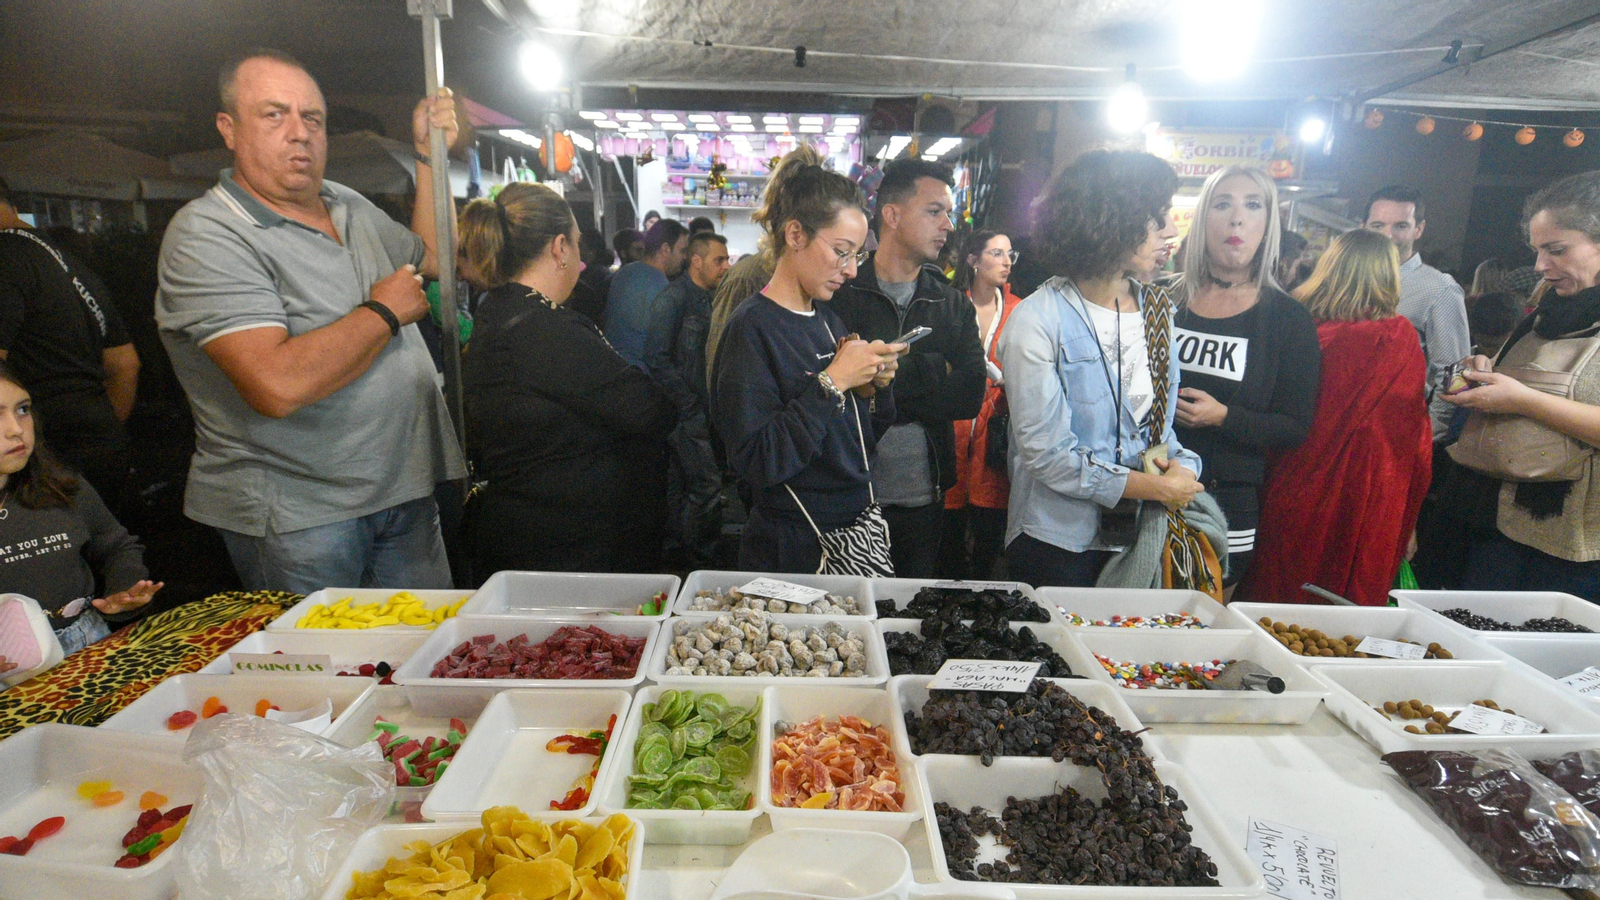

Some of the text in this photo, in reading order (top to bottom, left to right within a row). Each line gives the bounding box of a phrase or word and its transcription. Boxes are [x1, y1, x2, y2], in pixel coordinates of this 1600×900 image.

[17, 538, 39, 551] YOU
[43, 532, 69, 544] LOVE
[951, 681, 1004, 690] PASAS
